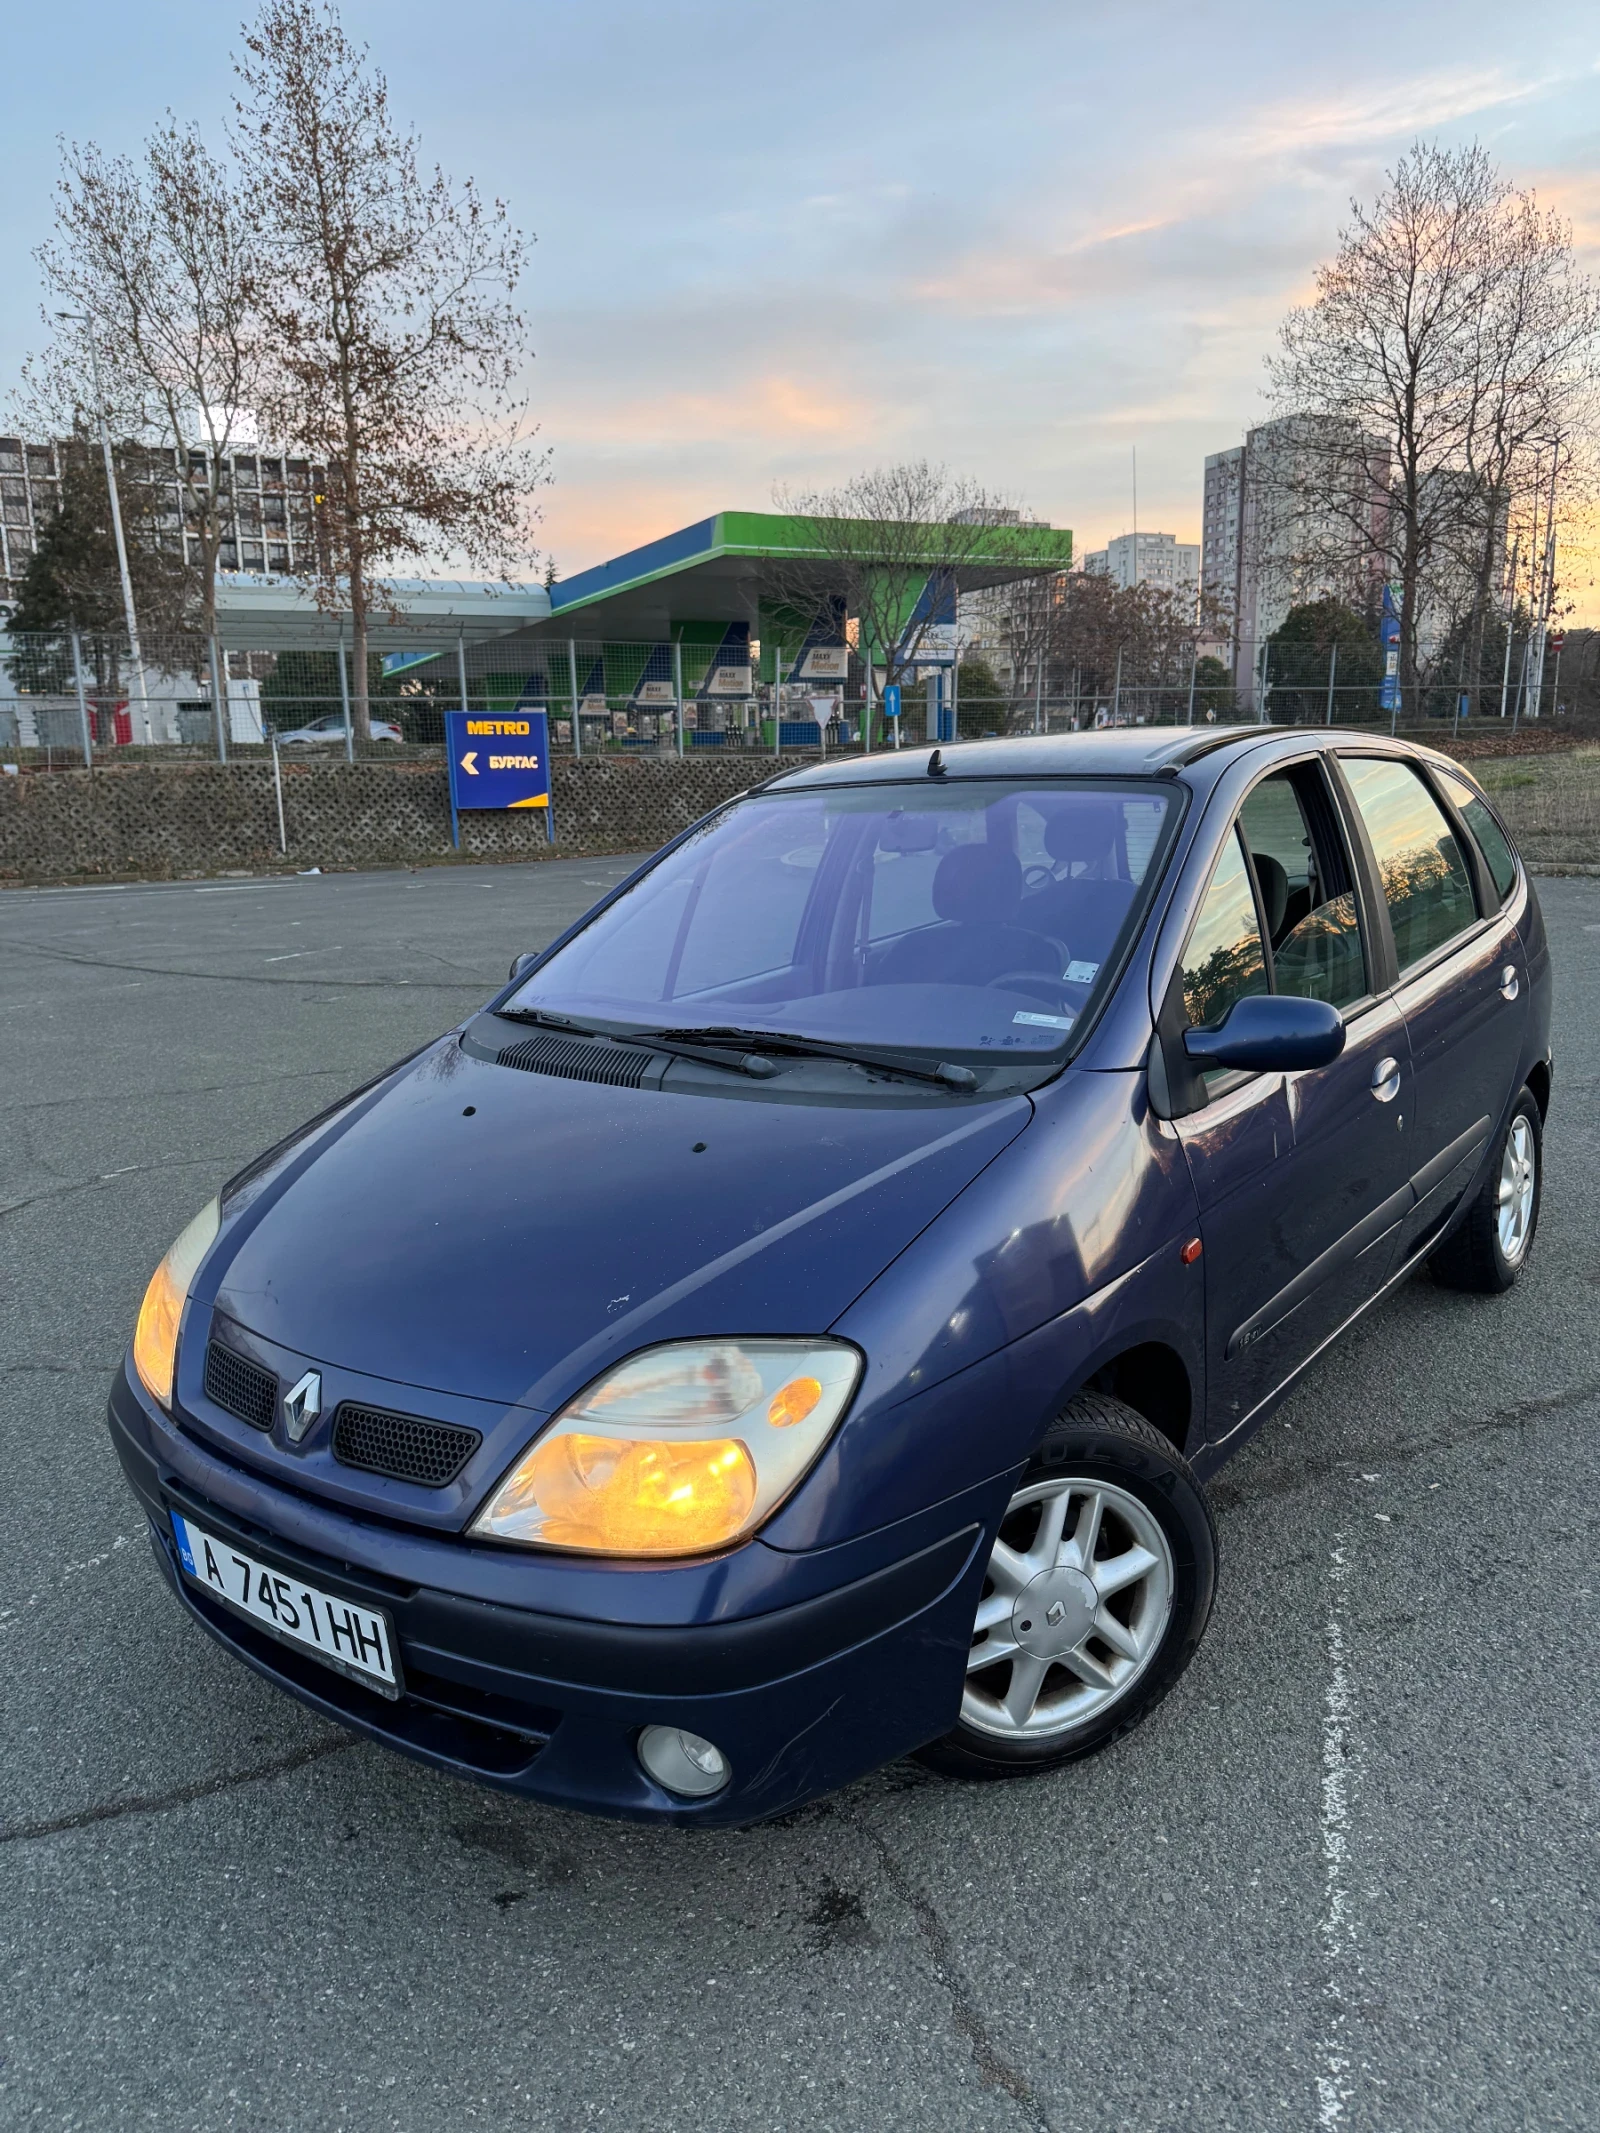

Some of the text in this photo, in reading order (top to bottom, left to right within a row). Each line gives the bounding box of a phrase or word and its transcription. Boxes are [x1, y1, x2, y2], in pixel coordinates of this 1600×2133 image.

[466, 721, 530, 735] METRO
[489, 755, 539, 769] БУРГАС
[181, 1547, 194, 1566] BG
[231, 1555, 321, 1643] 7451
